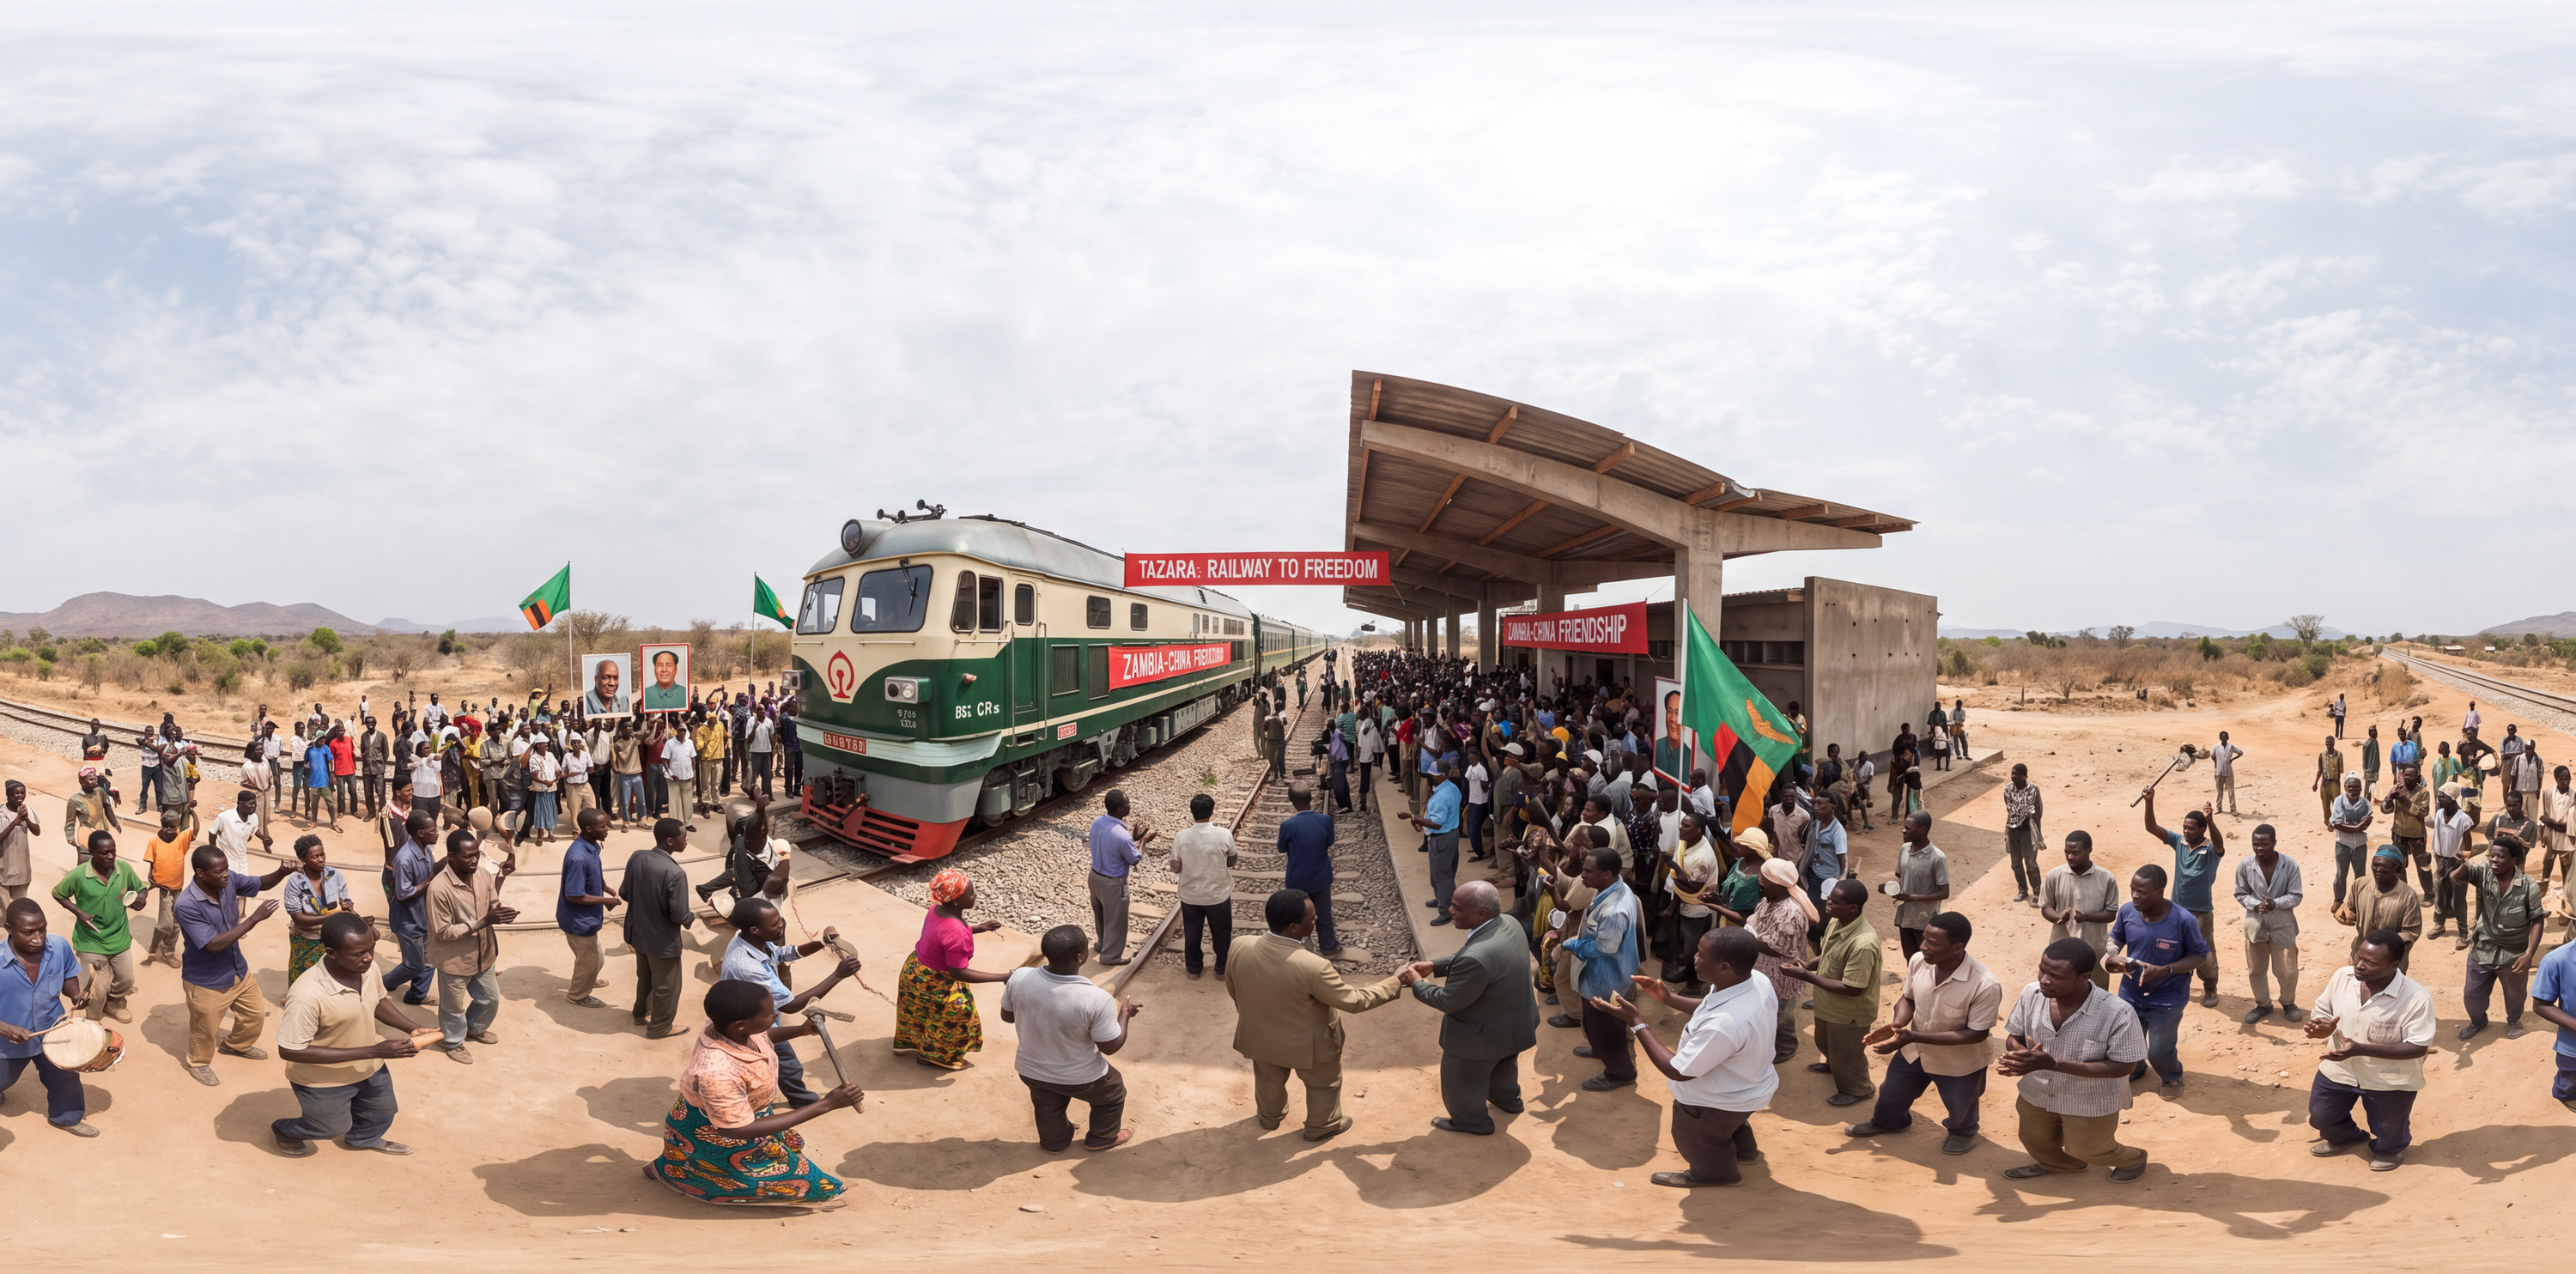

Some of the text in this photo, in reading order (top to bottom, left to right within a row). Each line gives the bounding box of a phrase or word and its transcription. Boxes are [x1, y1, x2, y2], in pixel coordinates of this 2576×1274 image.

[1138, 558, 1377, 579] TAZARA: RAILWAY TO FREEDOM
[1558, 614, 1627, 644] FRIENDSHIP
